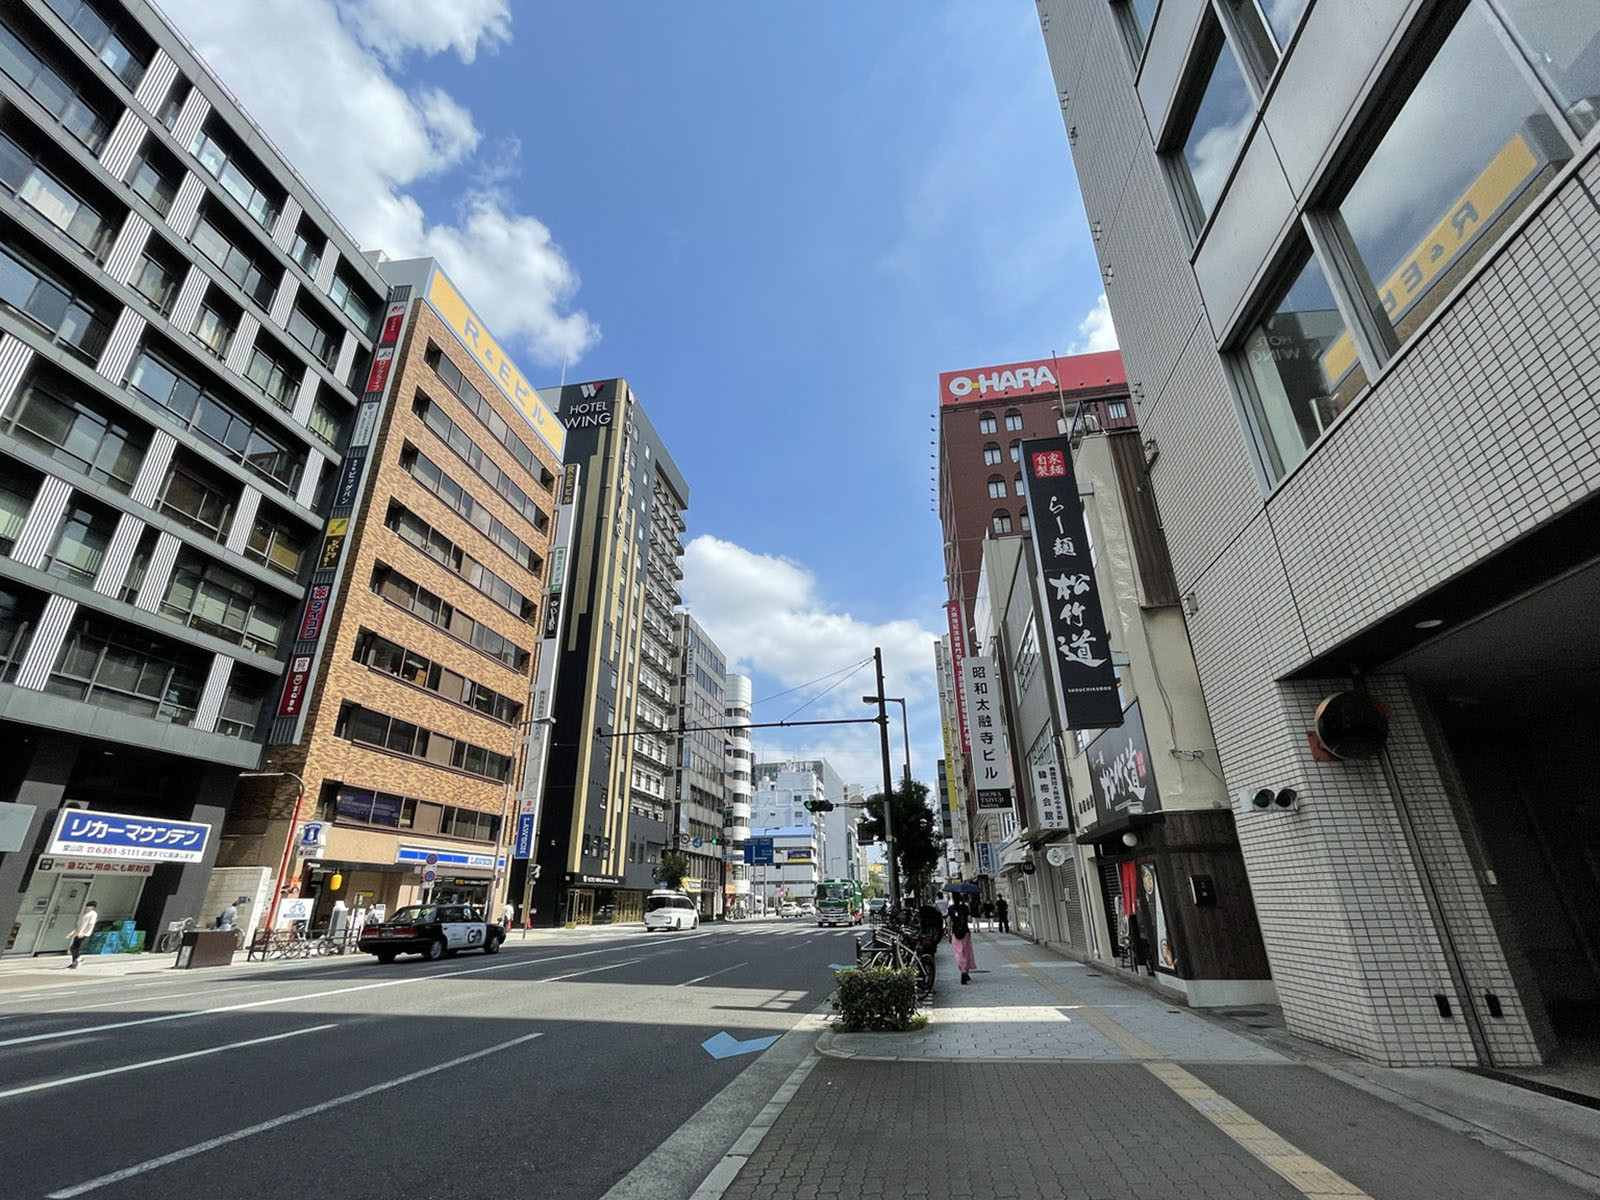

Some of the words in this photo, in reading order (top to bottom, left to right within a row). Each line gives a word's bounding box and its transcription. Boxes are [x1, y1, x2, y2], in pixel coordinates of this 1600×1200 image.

[463, 317, 545, 426] R&Eビル
[564, 412, 612, 430] WING
[570, 401, 608, 415] HOTEL
[972, 665, 999, 781] 昭和太融寺ビル
[70, 818, 200, 846] リカーマウンテン
